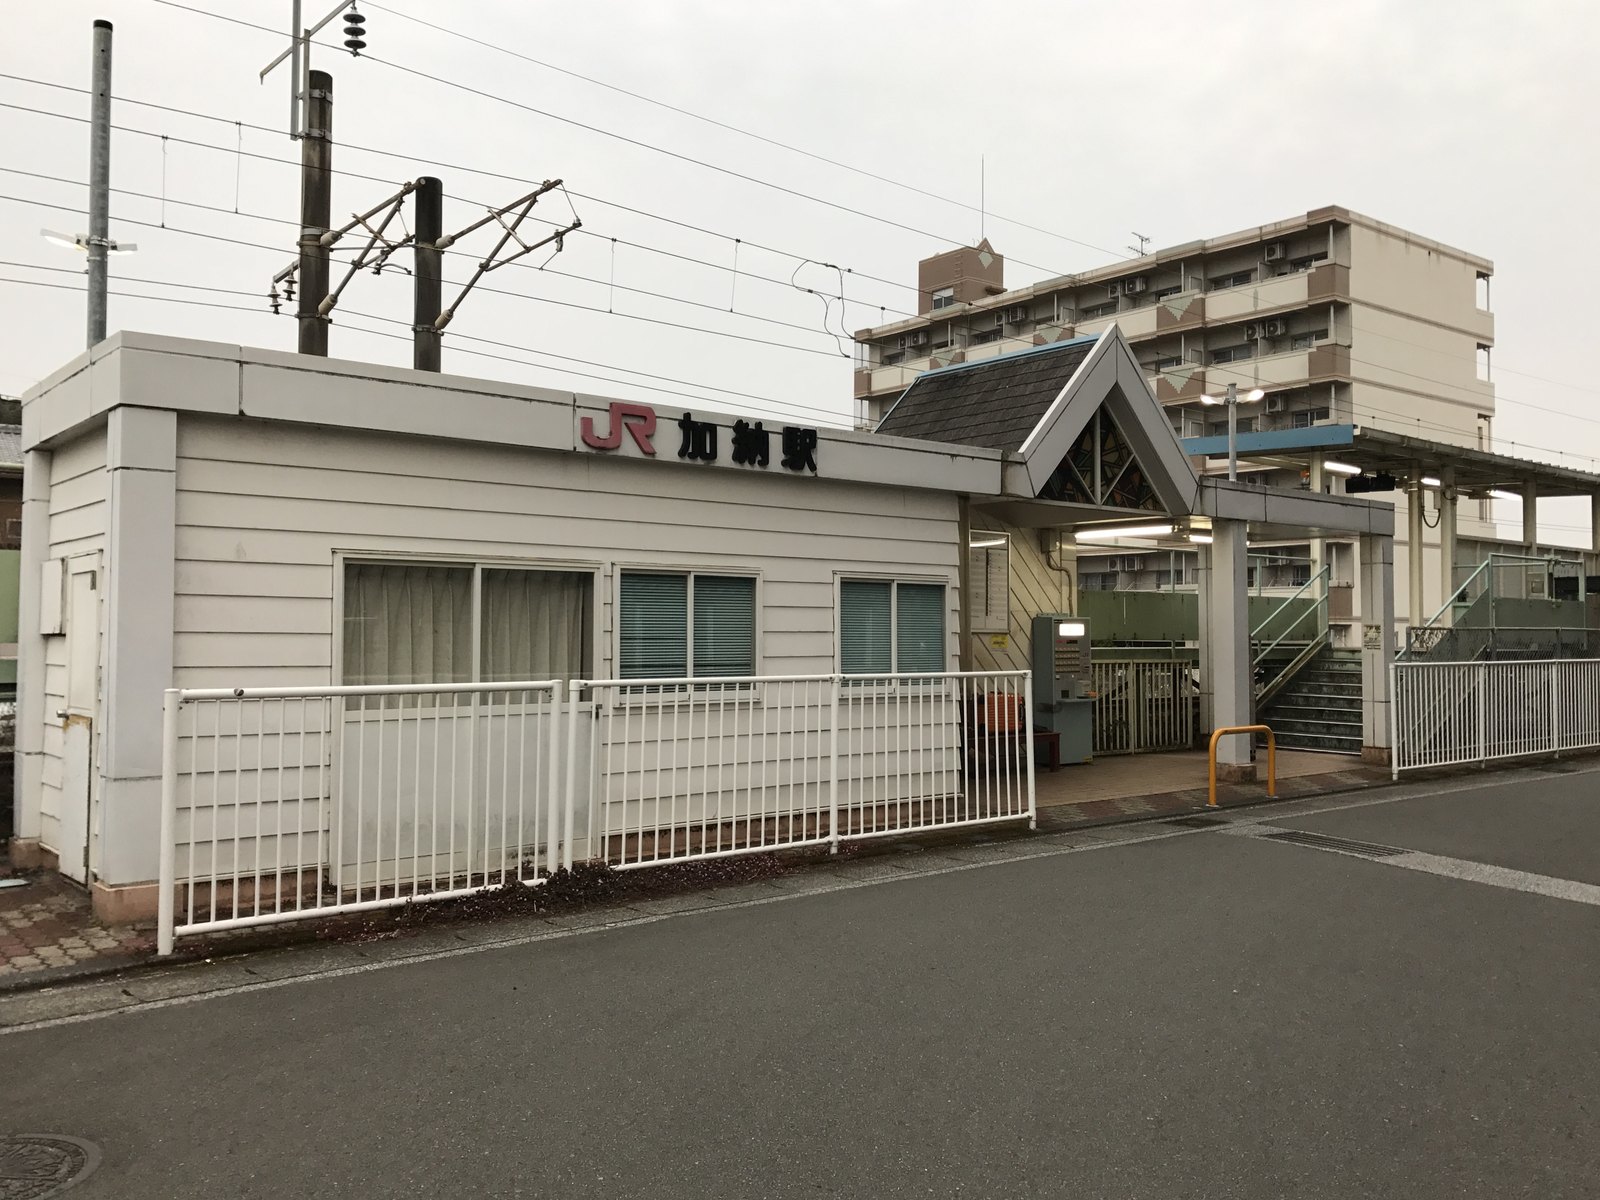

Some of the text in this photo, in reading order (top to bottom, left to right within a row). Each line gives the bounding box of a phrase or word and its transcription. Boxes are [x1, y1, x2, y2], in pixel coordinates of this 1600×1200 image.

[581, 402, 817, 472] JR 加納駅
